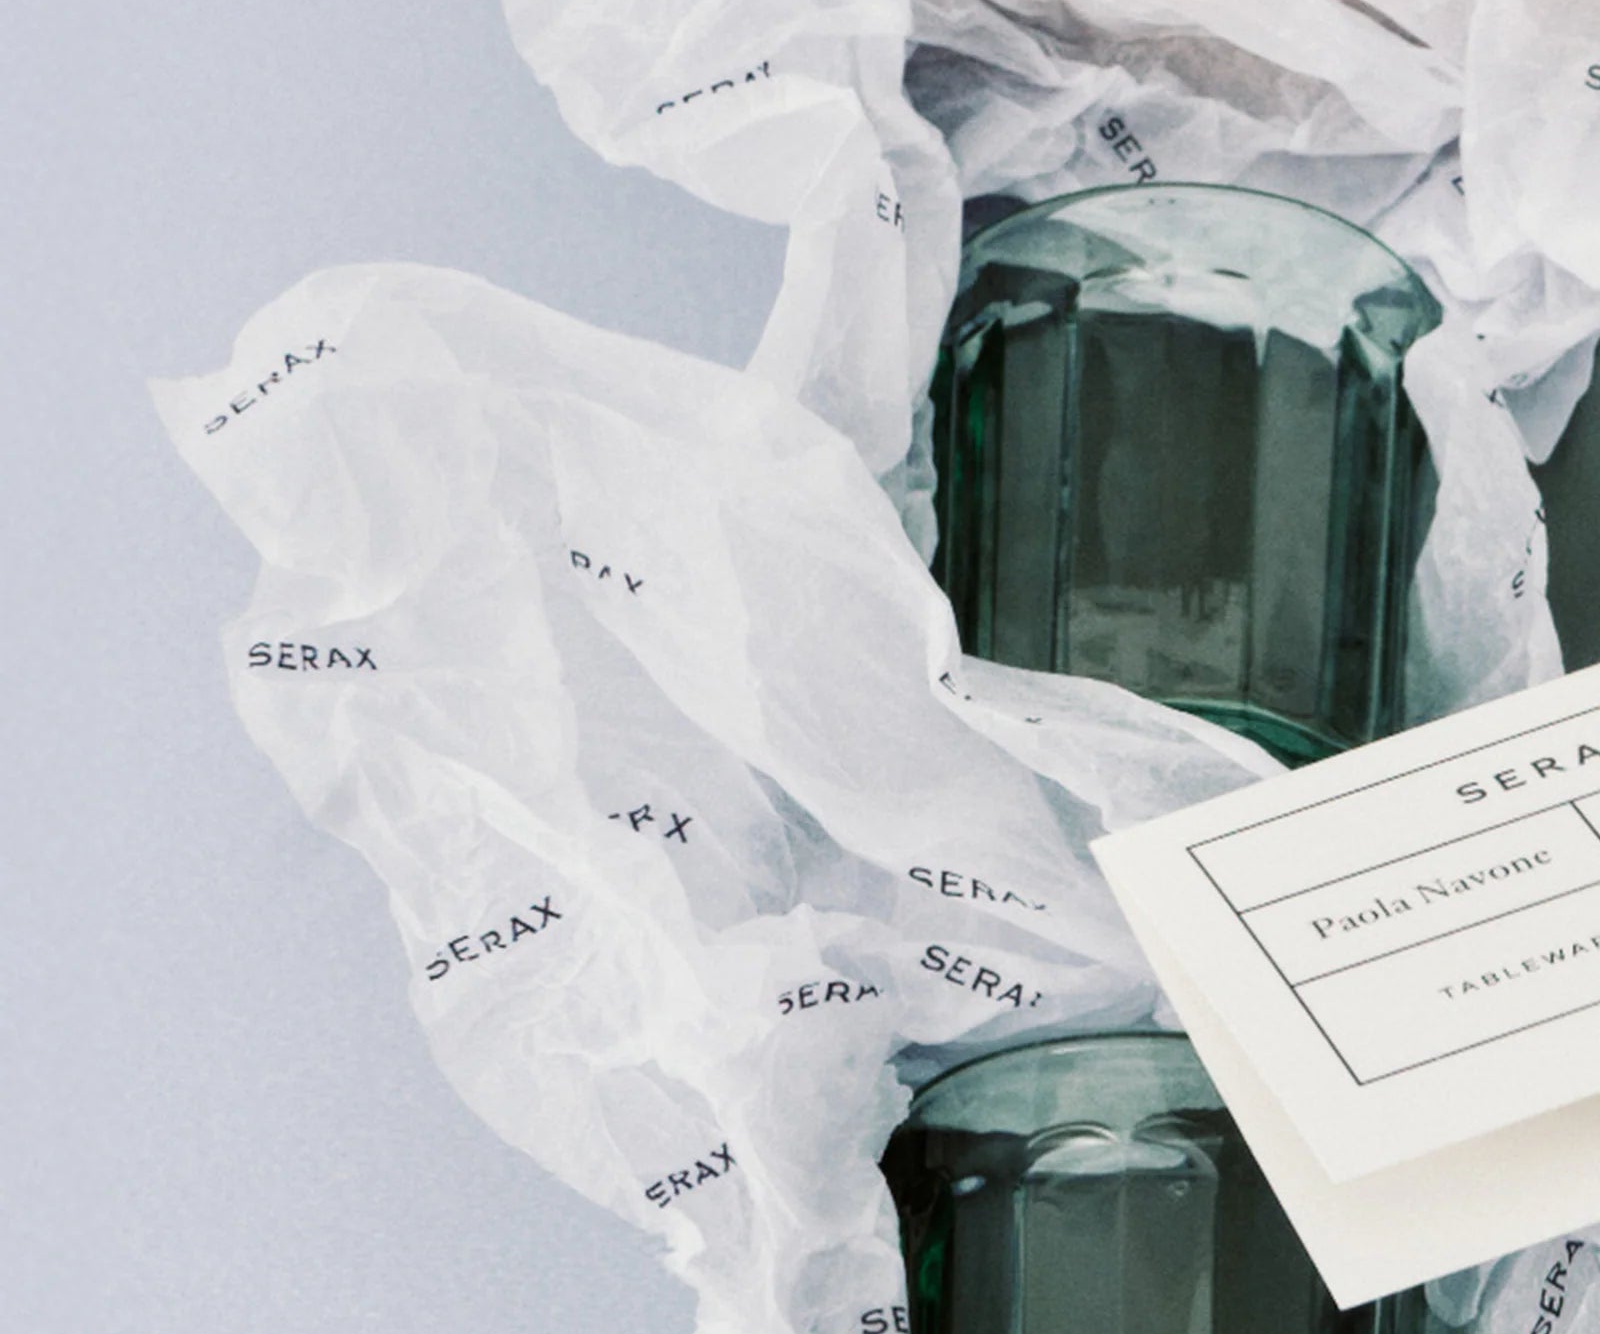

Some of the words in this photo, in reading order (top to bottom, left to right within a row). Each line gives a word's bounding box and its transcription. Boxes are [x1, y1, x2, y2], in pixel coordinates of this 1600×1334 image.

[1098, 116, 1157, 186] SER
[249, 642, 378, 671] SERAX
[1309, 896, 1412, 941] Paola
[1416, 847, 1552, 903] Navone
[425, 896, 562, 981] SERAX
[645, 1142, 737, 1208] ERAX
